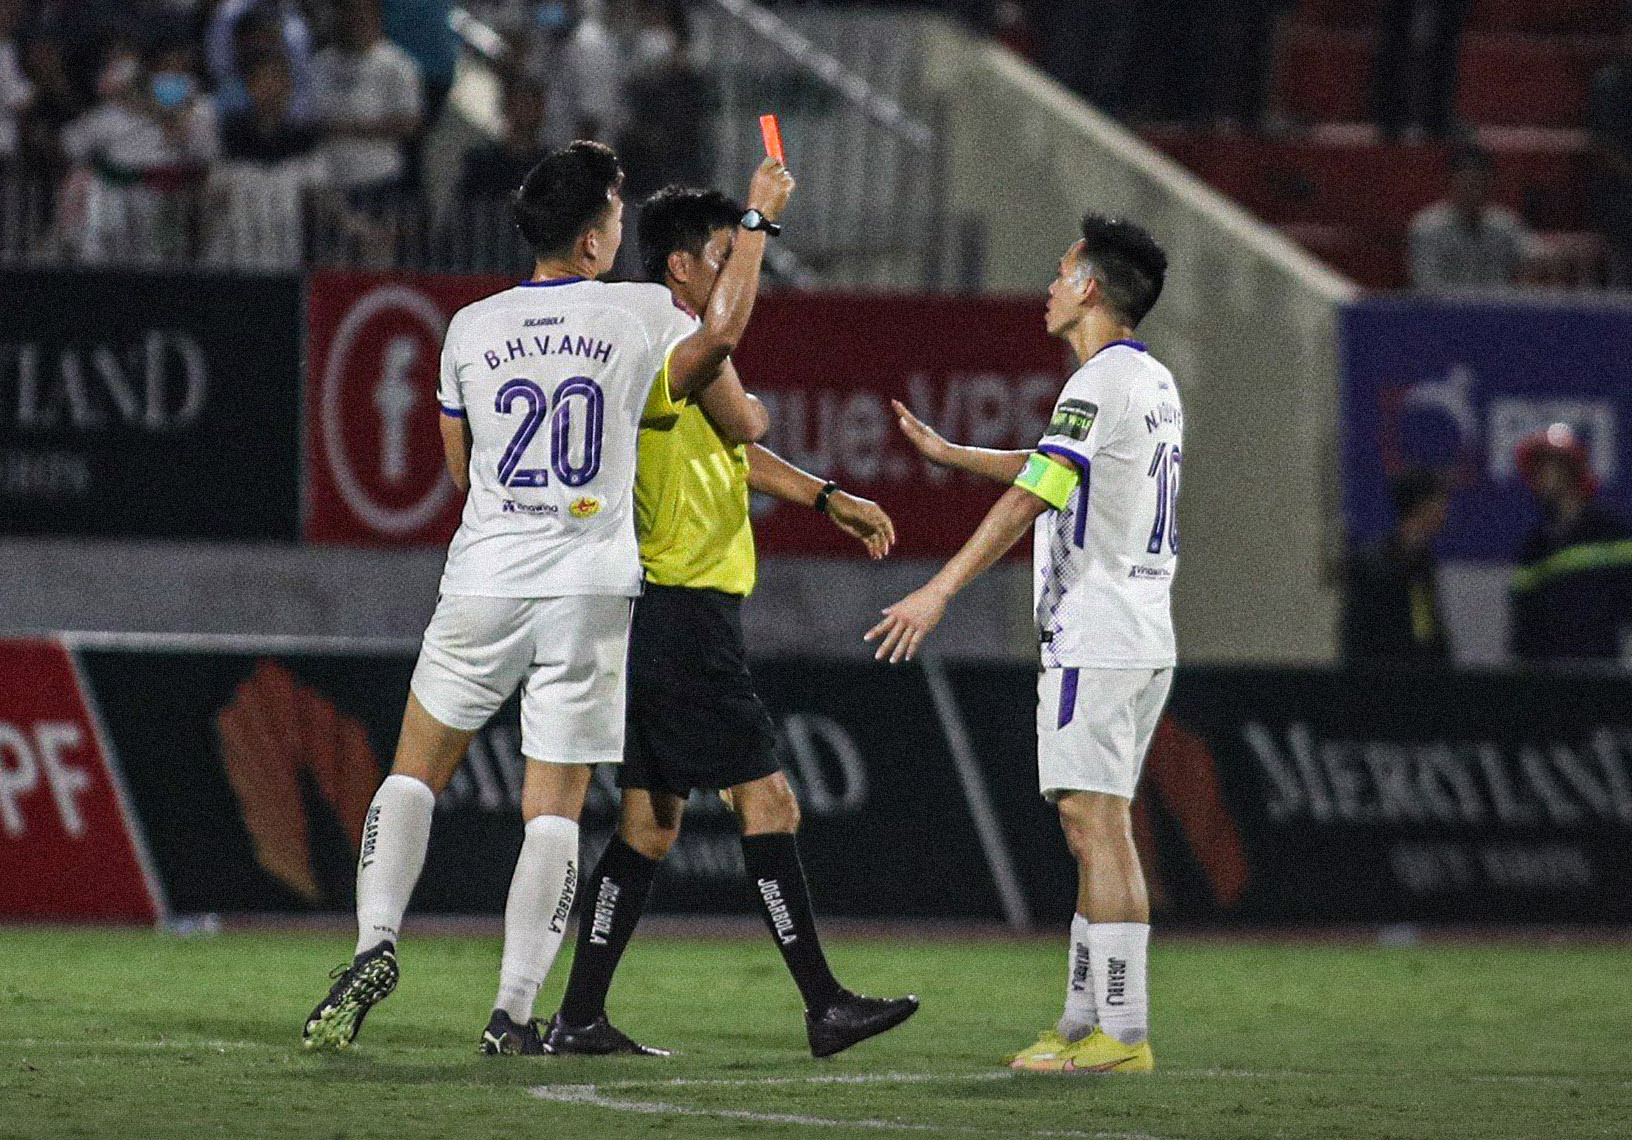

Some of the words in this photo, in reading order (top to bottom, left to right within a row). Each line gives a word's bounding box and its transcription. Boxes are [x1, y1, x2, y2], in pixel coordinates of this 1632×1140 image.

[484, 334, 613, 371] B.H.V.ANH
[494, 375, 604, 489] 20
[548, 860, 579, 934] JOGARBOLA
[757, 878, 798, 945] JOGARBOLA
